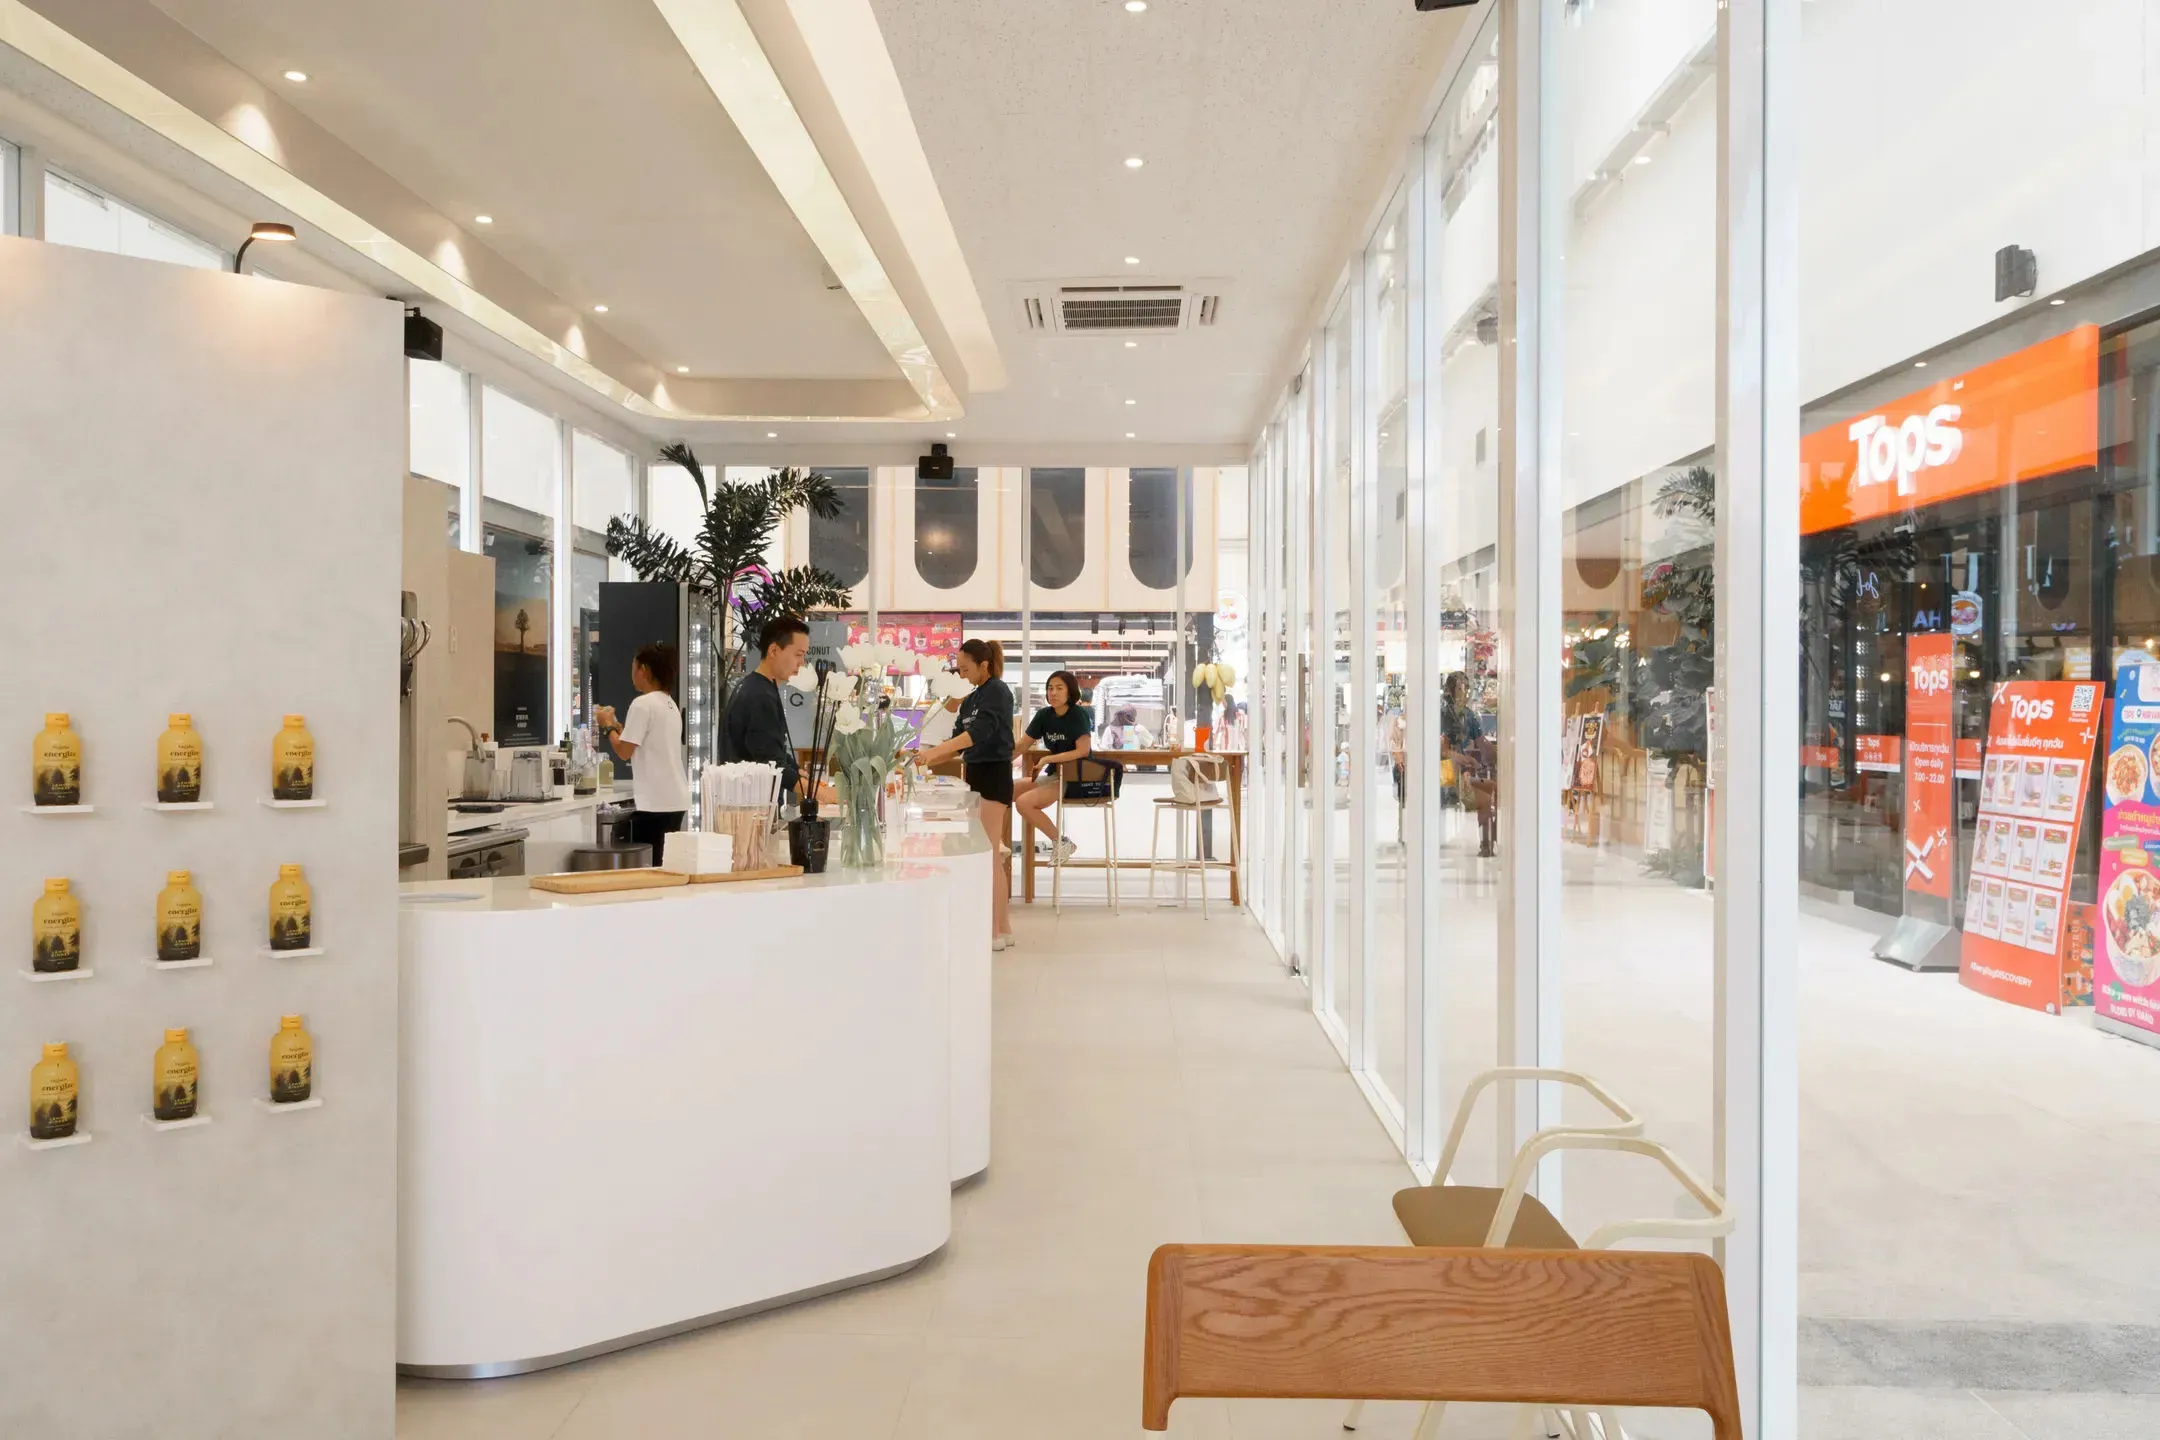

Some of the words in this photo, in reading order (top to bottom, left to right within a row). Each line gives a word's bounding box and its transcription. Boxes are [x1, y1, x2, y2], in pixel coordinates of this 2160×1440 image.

[1848, 404, 1962, 496] Tops
[806, 646, 830, 656] CONUT
[1911, 665, 1949, 696] Tops
[2010, 695, 2055, 726] Tops
[1915, 756, 1929, 768] Open
[1930, 757, 1943, 770] daily
